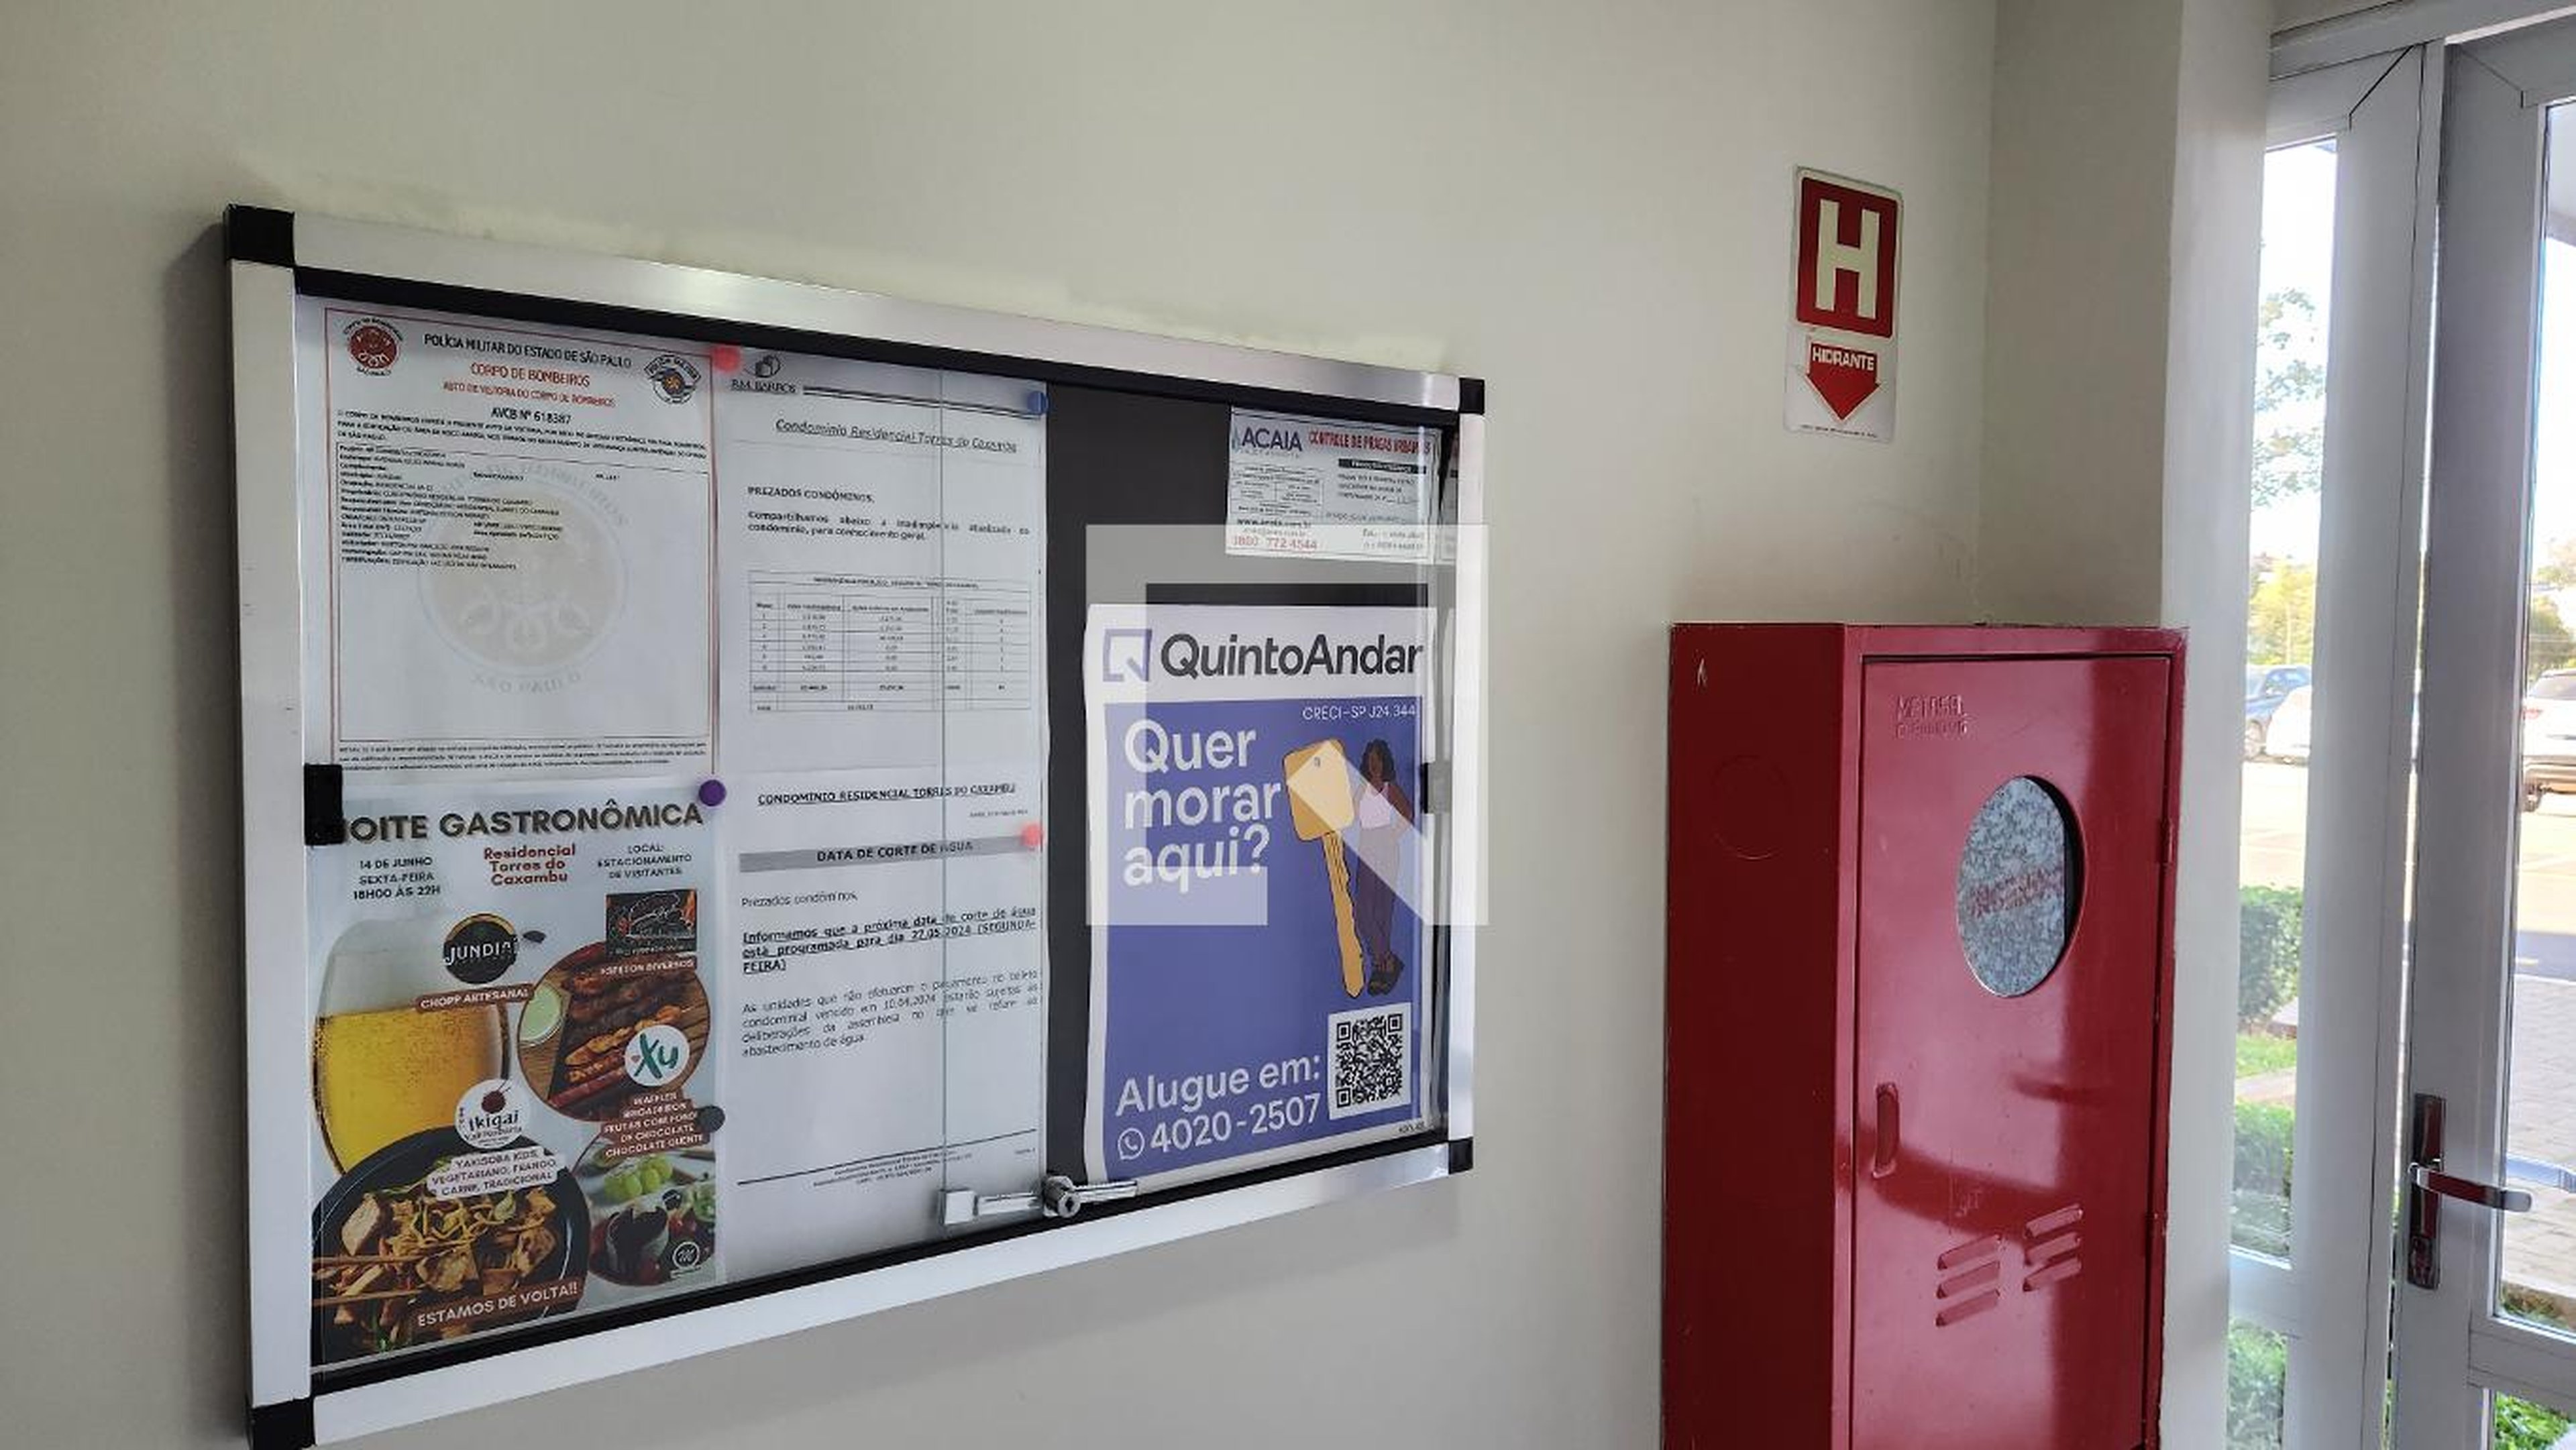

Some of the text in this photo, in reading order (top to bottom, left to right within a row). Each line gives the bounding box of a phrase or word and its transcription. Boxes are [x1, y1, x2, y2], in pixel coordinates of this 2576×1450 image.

[1815, 199, 1880, 319] H
[424, 333, 631, 368] POLÍCIA MILITAR DO ESTADO DE SÃO PAULO
[1813, 347, 1874, 371] HIDRANTE
[471, 362, 590, 386] CORPO DE BOMBEIROS
[491, 407, 516, 420] AVCB
[535, 410, 570, 424] 618387
[1242, 427, 1303, 451] ACAIA
[748, 487, 801, 497] PREZADOS
[1161, 633, 1423, 679] QuintoAndar
[1302, 706, 1366, 720] CRECI-SP
[1124, 719, 1256, 773] Quer
[840, 789, 908, 801] RESIDENCIAL
[1124, 781, 1281, 829] morar
[343, 799, 703, 841] OITE GASTRONÔMICA
[484, 843, 576, 860] Residencial
[598, 854, 692, 868] ESTACIONAMENTO
[817, 850, 853, 862] DATA
[857, 848, 873, 858] DE
[877, 845, 917, 858] CORTE
[921, 843, 936, 854] DE
[1124, 823, 1270, 894] aqui?
[360, 856, 432, 869] 14 DE JUNHO
[490, 858, 566, 873] Torres do
[360, 873, 435, 885] SEXTA-FEIRA
[491, 871, 568, 886] Caxambu
[417, 886, 440, 895] 22H
[742, 895, 790, 906] Prezados
[743, 929, 818, 944] Informamos
[824, 926, 845, 938] que
[914, 915, 936, 926] data
[421, 995, 461, 1009] CHOPP
[634, 1033, 678, 1079] Xu
[1116, 1055, 1320, 1117] Alugue em:
[606, 1142, 664, 1158] CHOCOLATE
[417, 1281, 578, 1327] ESTAMOS DE VOLTA!!
